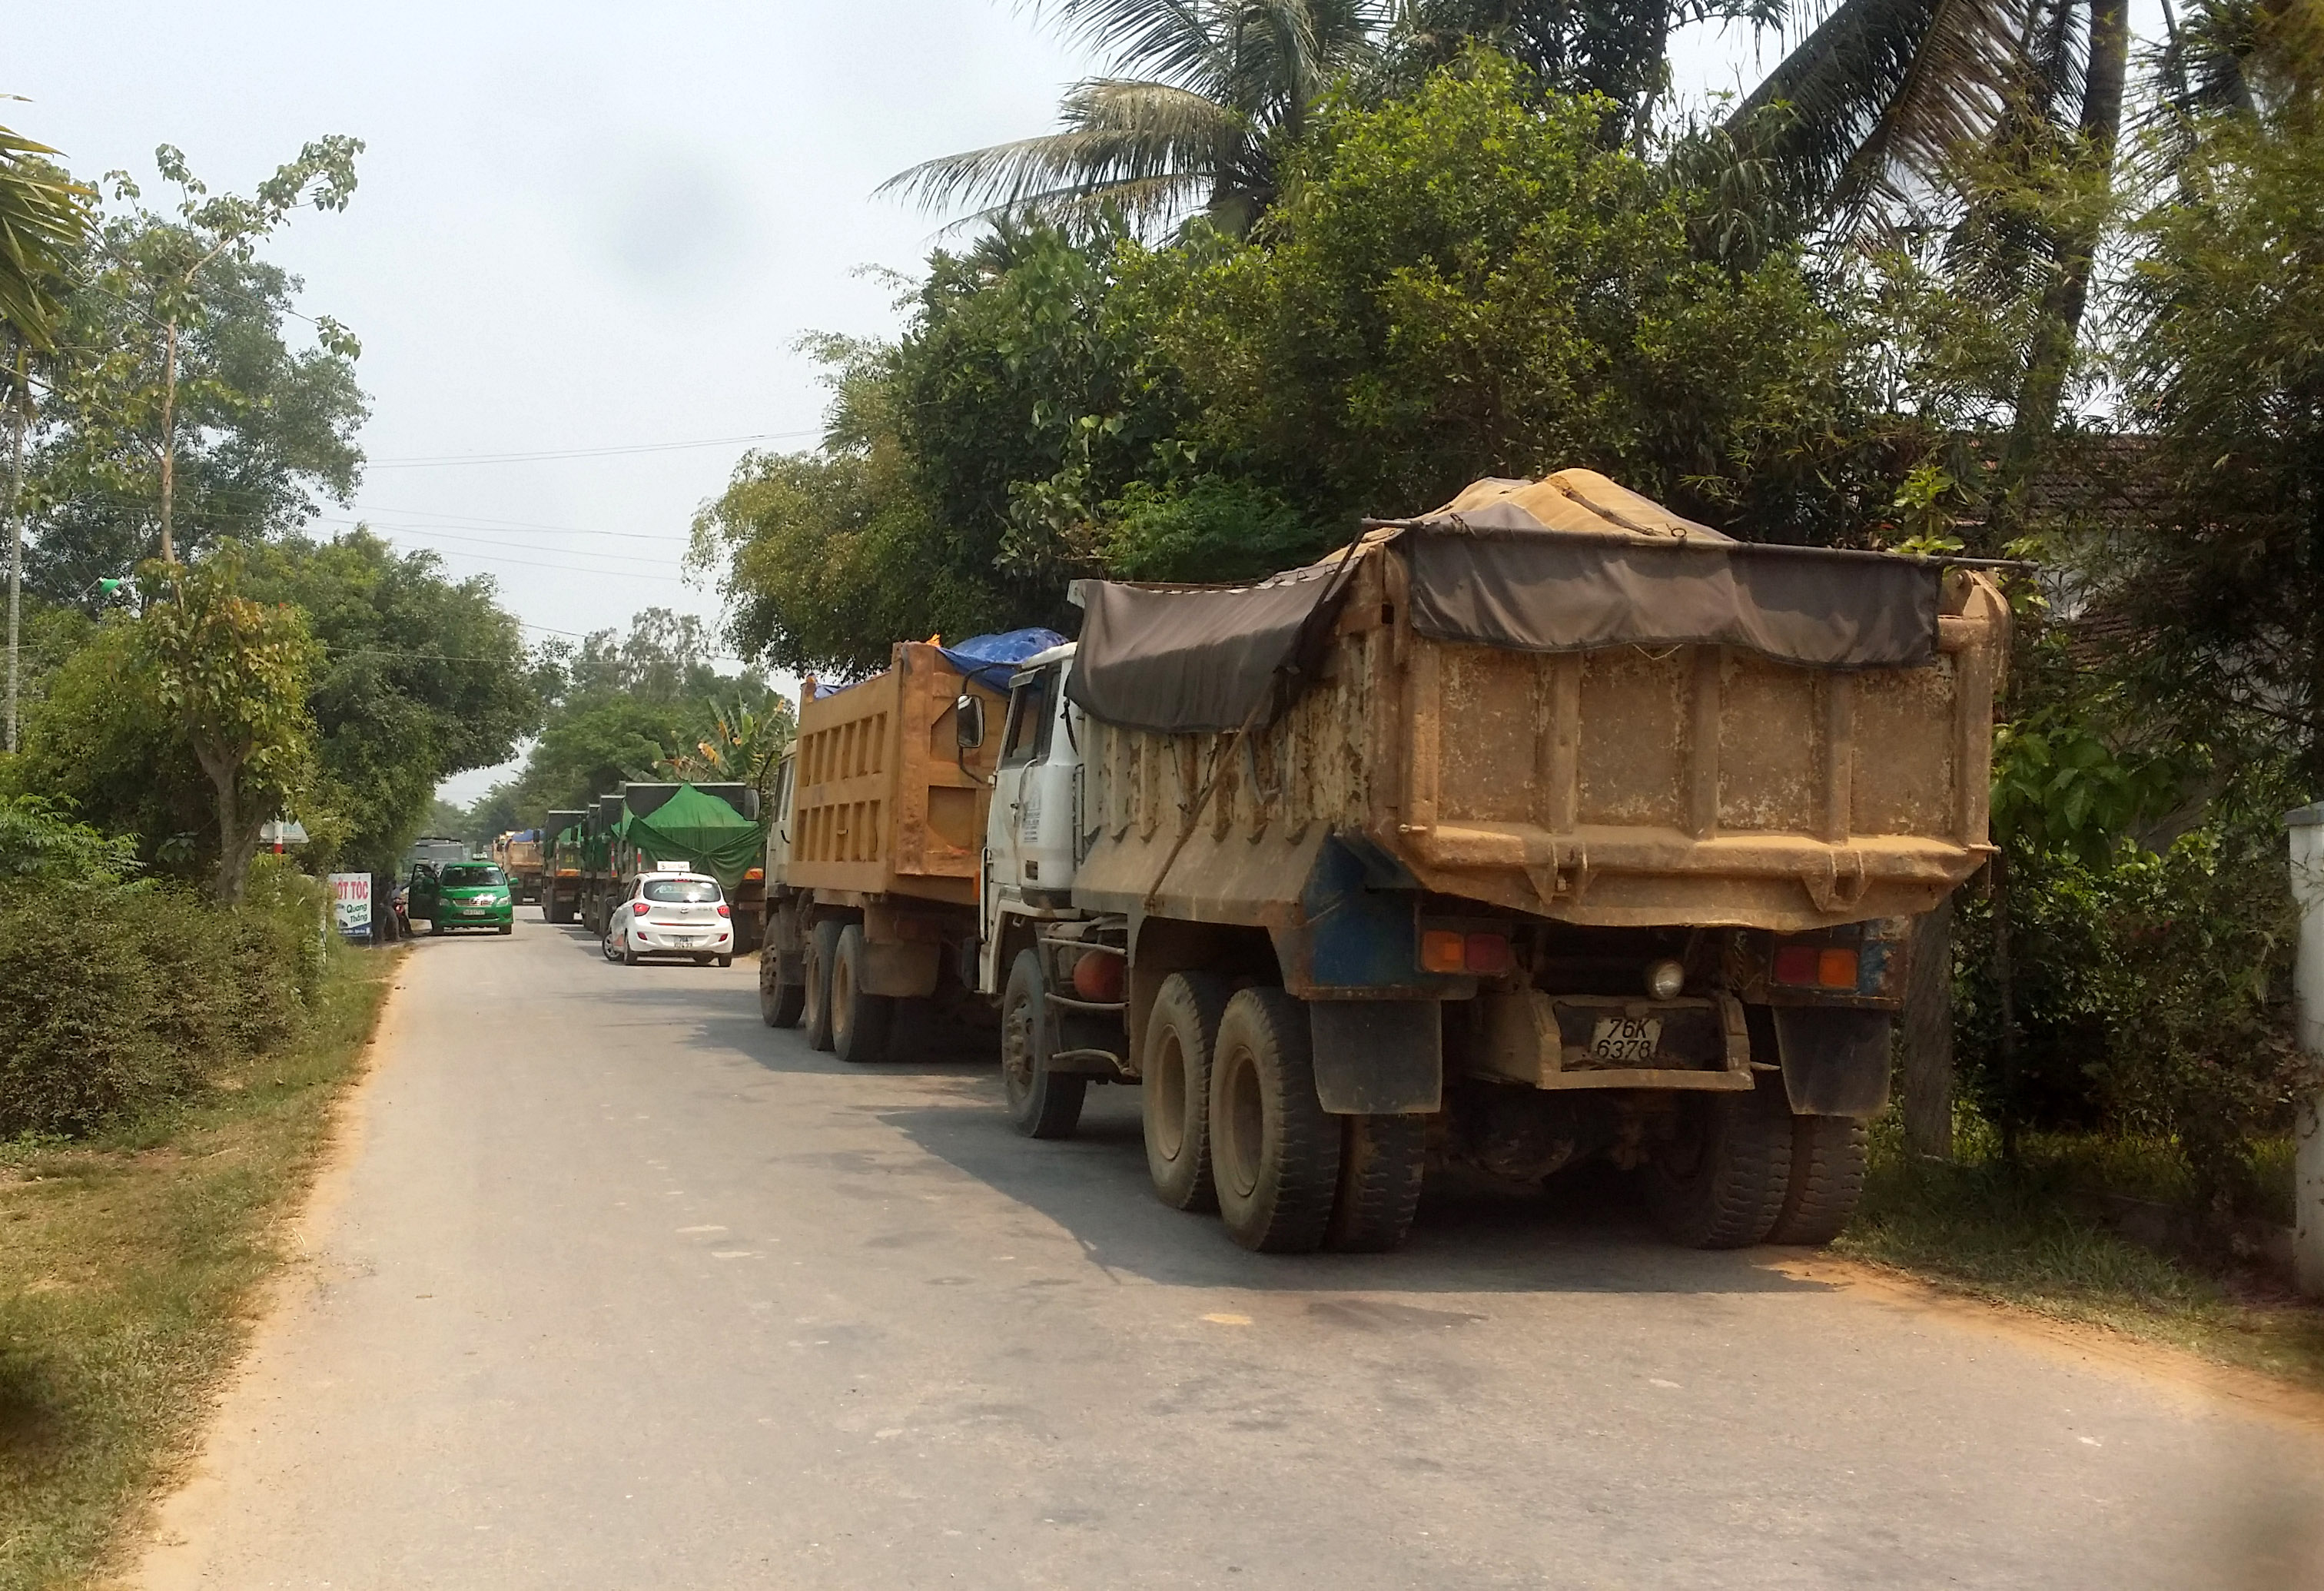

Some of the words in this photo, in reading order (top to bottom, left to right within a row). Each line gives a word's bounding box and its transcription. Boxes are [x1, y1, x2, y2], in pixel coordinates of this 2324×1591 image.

[334, 876, 348, 899] ỚT
[350, 875, 368, 899] TÓC
[347, 904, 367, 913] Quang
[1607, 1018, 1650, 1038] 76K
[1597, 1039, 1651, 1059] 6378
